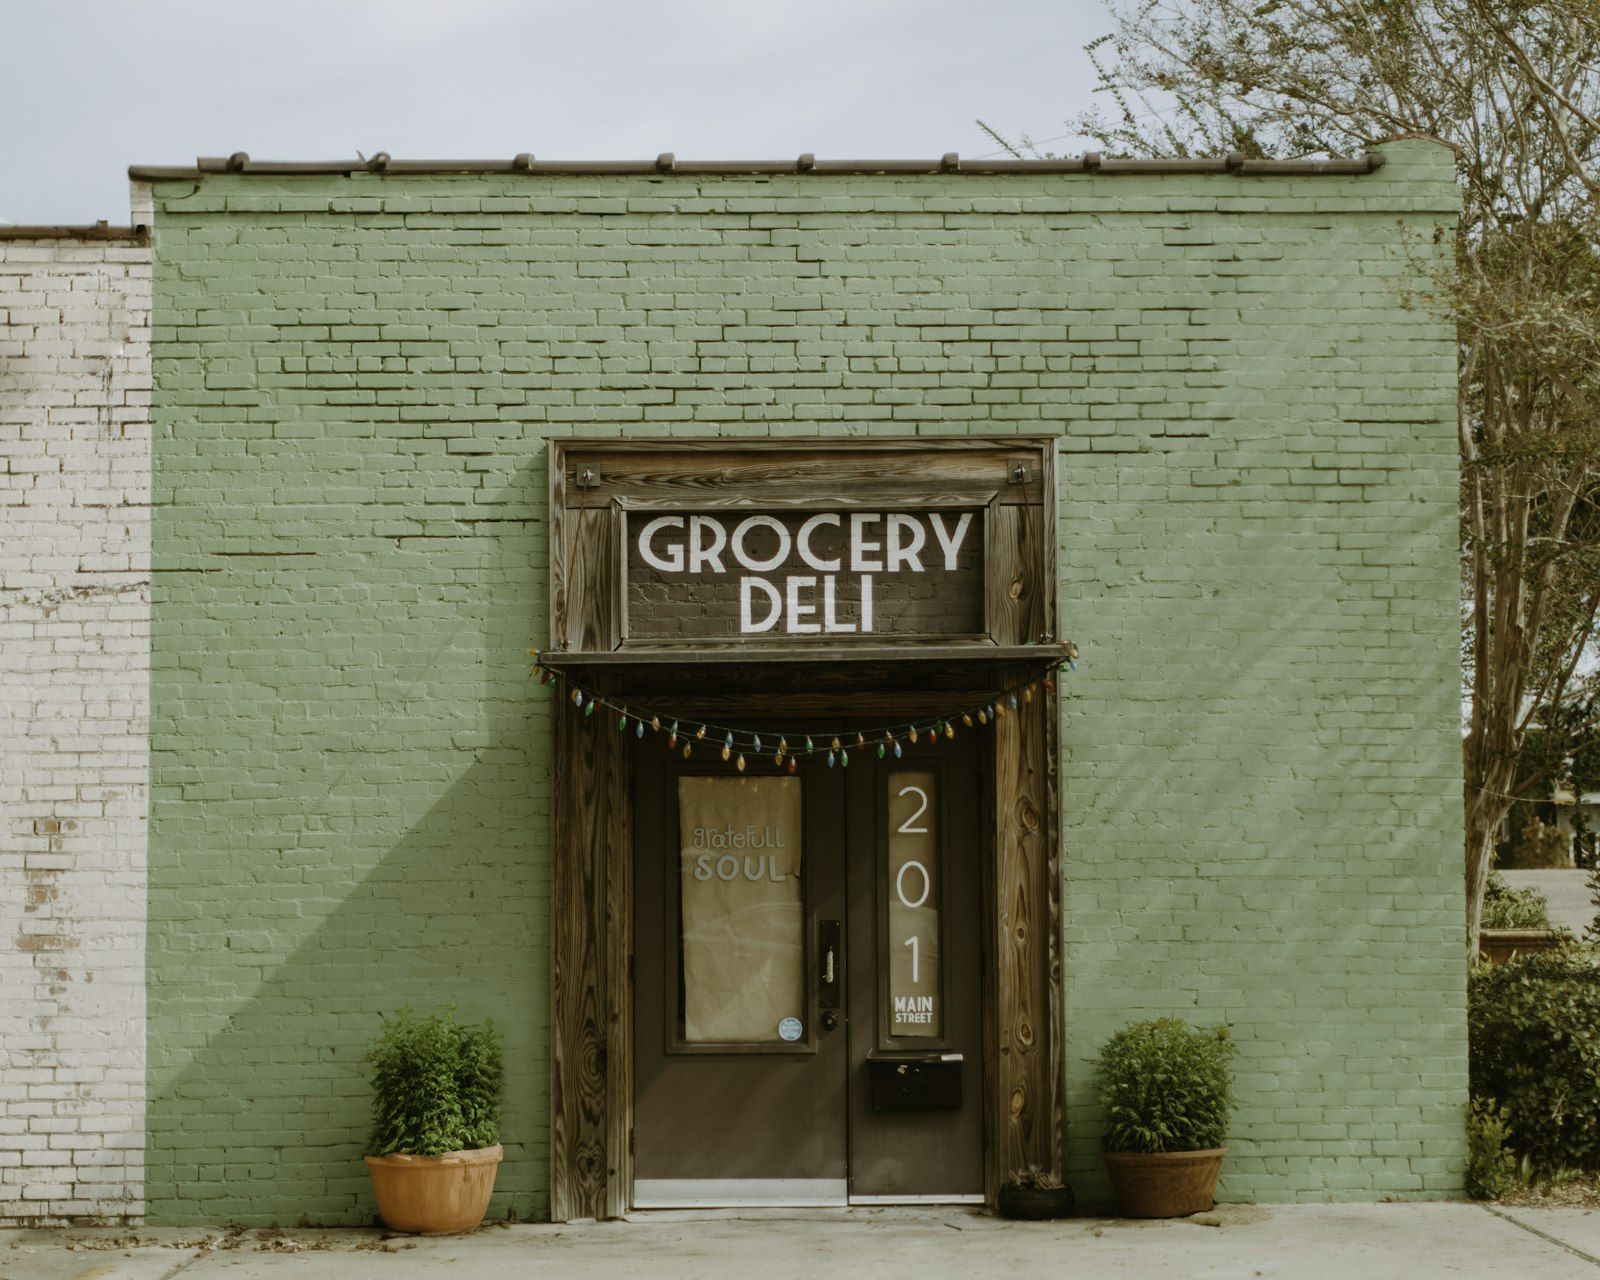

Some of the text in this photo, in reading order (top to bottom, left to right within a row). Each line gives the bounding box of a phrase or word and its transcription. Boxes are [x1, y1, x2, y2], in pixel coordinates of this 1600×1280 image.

[638, 513, 974, 573] GROCERY
[740, 574, 873, 634] DELI
[694, 854, 786, 881] SOUL
[894, 996, 933, 1012] MAIN
[895, 1012, 933, 1023] STREET
